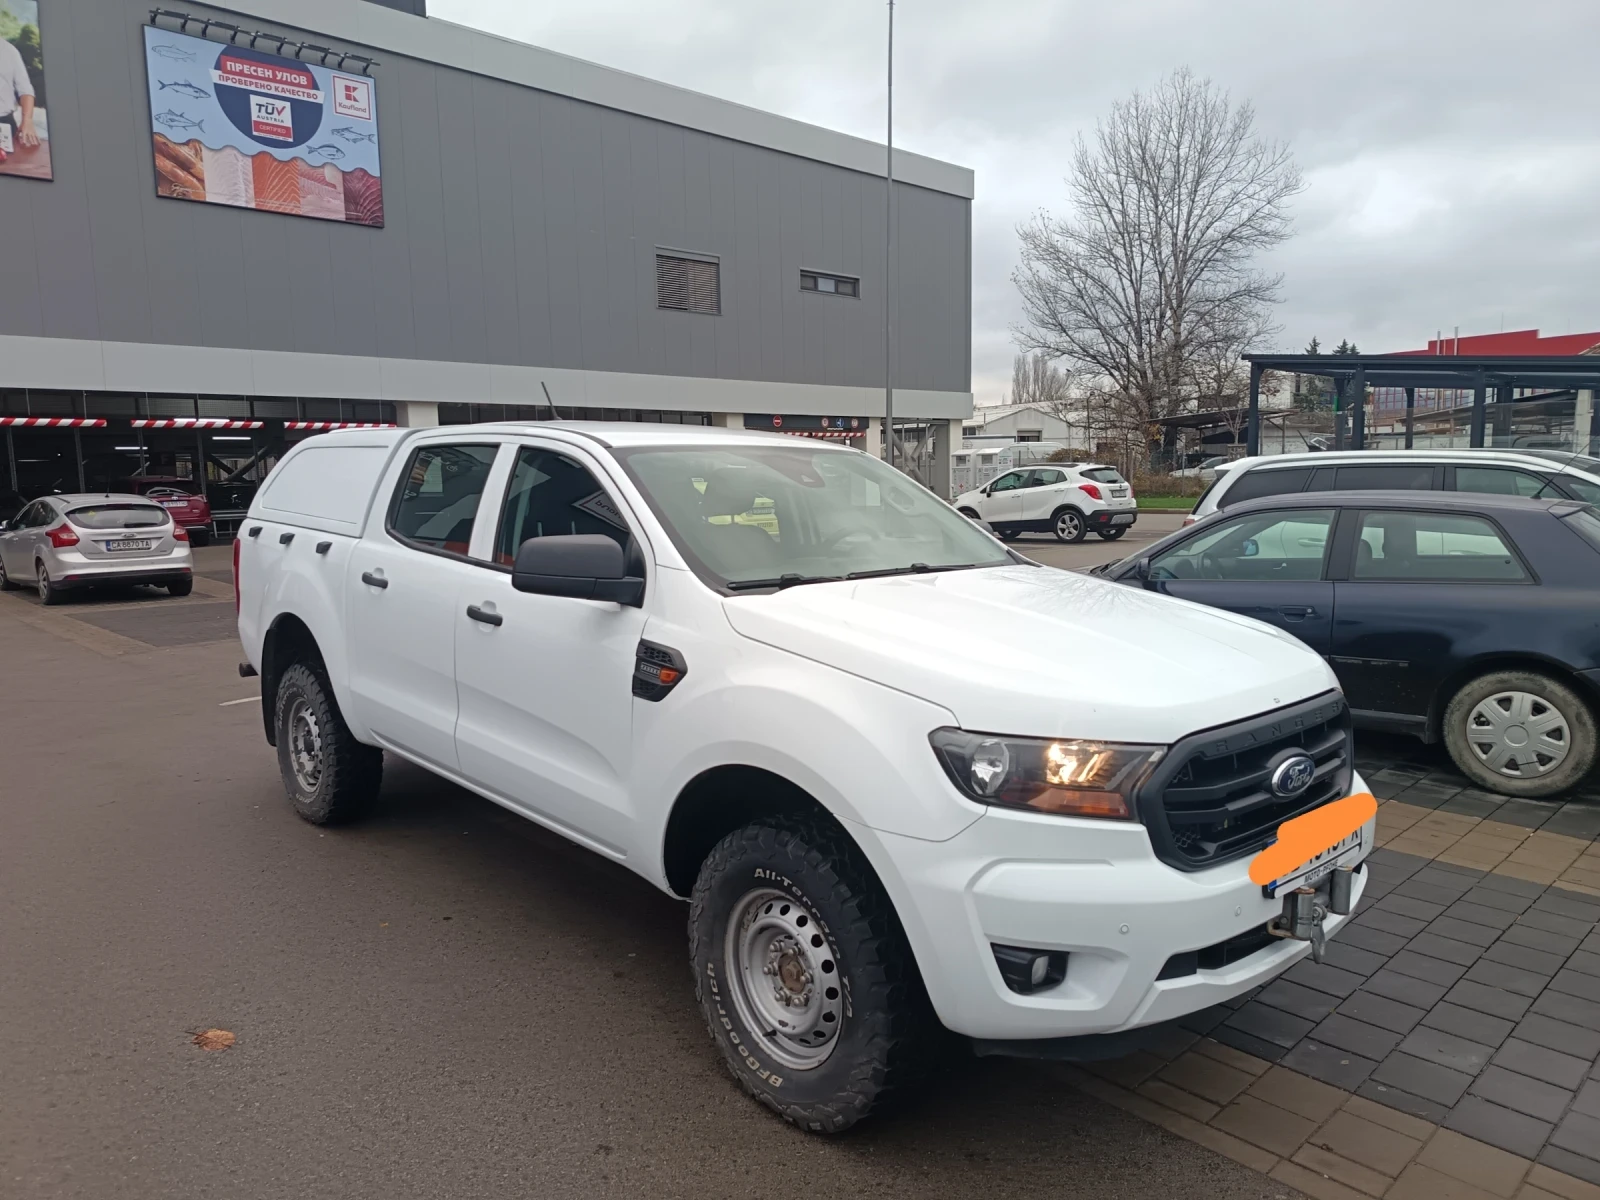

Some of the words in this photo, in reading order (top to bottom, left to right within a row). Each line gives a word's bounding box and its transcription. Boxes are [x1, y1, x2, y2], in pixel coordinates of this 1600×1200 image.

[226, 61, 273, 79] ПРЕСЕН
[275, 70, 308, 85] УЛОВ
[218, 74, 273, 91] ПРОВЕРЕНО
[274, 86, 318, 100] КАЧЕСТВО
[256, 114, 285, 124] AUSTRIA
[338, 101, 367, 114] Kaufland
[259, 124, 287, 135] CERTIFIED
[122, 540, 140, 548] 8870
[1216, 702, 1339, 753] RANGER
[1287, 761, 1312, 790] Ford
[754, 868, 841, 960] All-Terrain
[707, 962, 784, 1088] BFGoodrich
